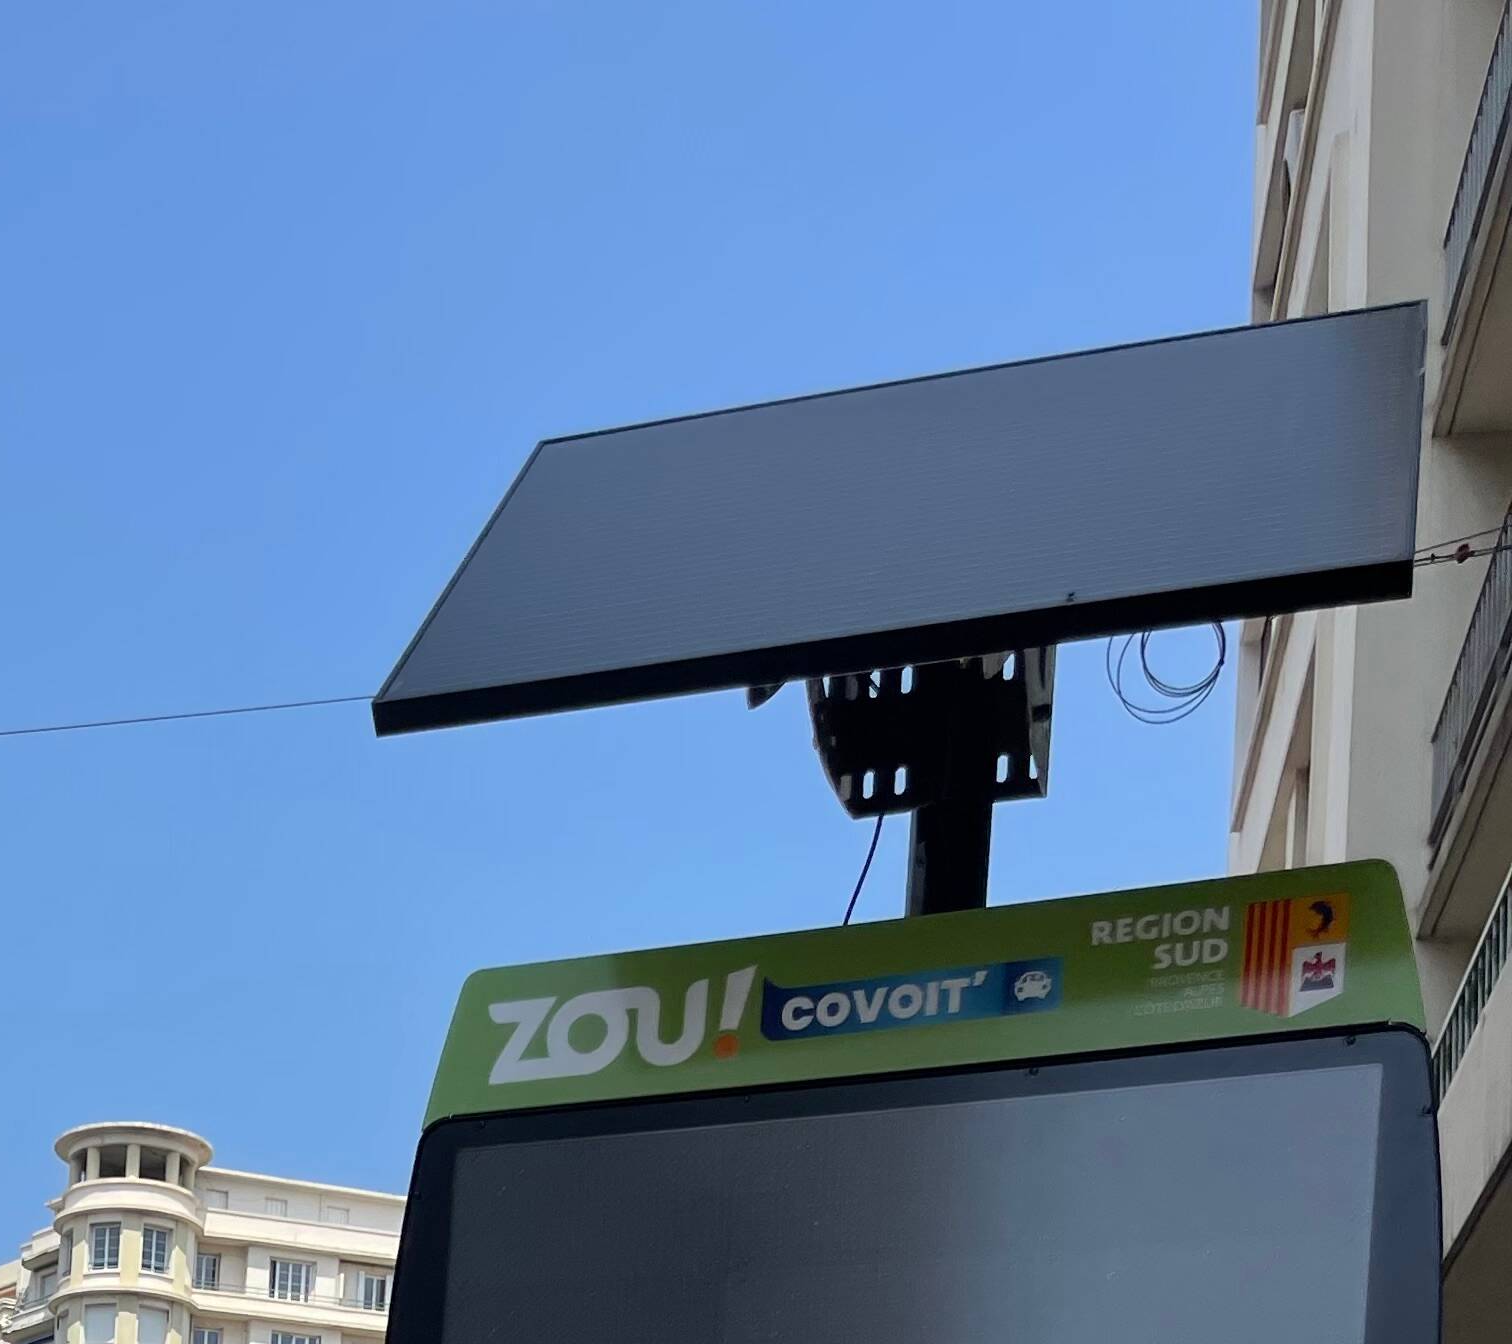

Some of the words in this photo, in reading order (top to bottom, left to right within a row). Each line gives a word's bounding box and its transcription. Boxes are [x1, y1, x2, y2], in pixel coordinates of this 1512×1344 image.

[1090, 905, 1230, 947] REGION
[1152, 937, 1229, 971] SUD
[487, 963, 759, 1086] ZOU!
